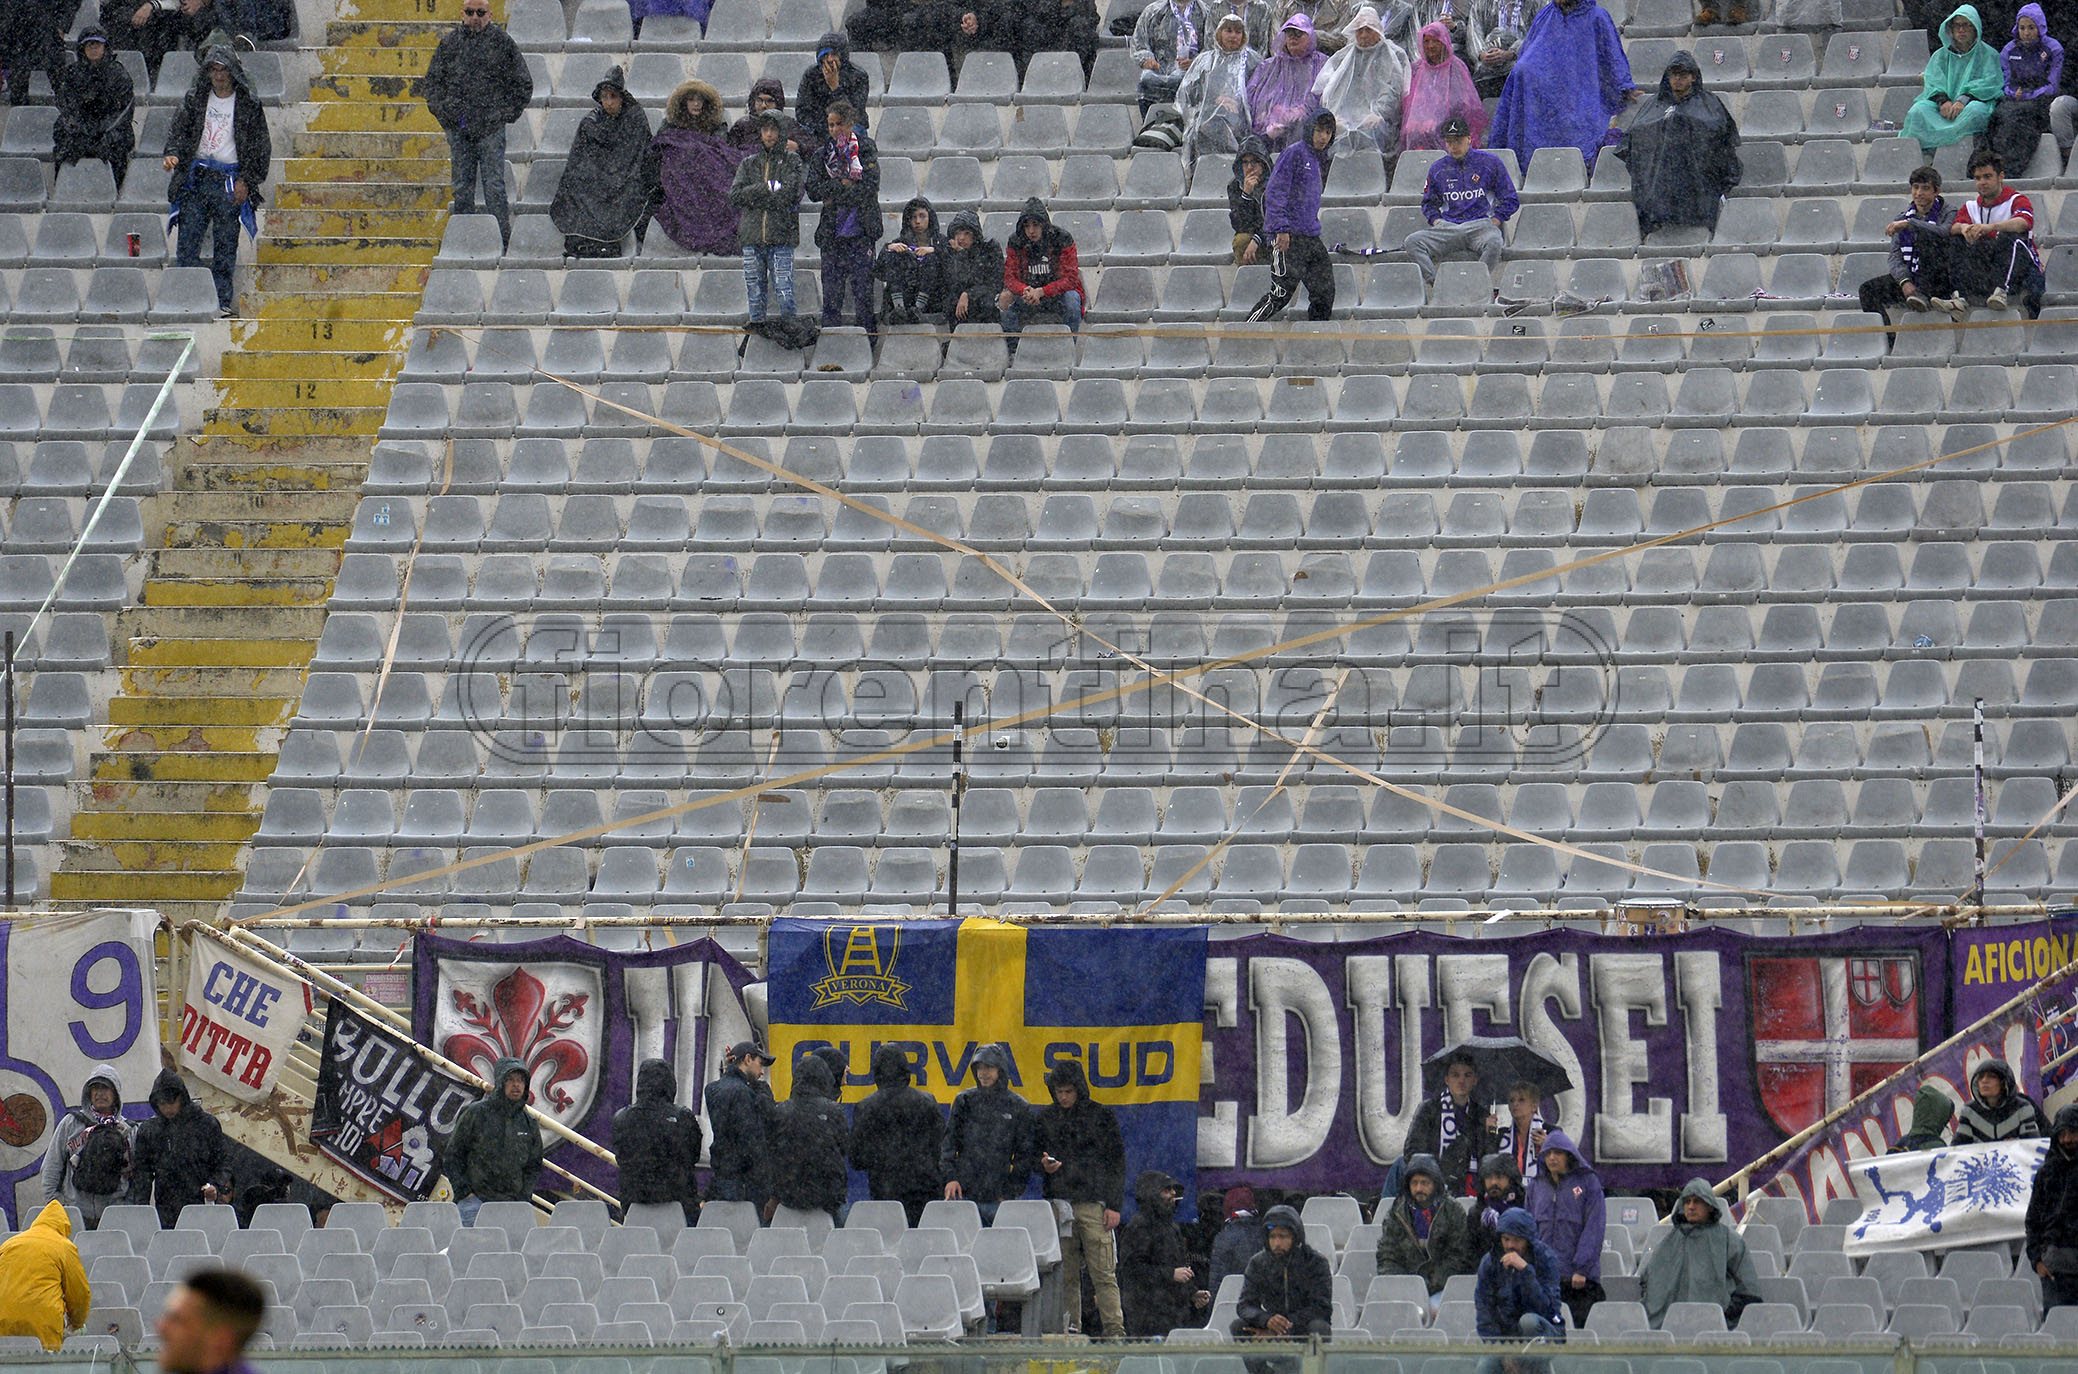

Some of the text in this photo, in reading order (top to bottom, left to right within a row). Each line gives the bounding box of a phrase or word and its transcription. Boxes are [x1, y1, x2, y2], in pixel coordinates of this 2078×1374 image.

[1443, 188, 1486, 201] TOYOTA
[311, 323, 334, 340] 13
[294, 384, 317, 399] 12
[1963, 933, 2078, 986] AFICION
[67, 940, 144, 1061] 9
[203, 960, 283, 1030] CHE
[831, 977, 887, 992] VERONA
[180, 1002, 273, 1090] DITTA
[1043, 1040, 1174, 1088] SUD
